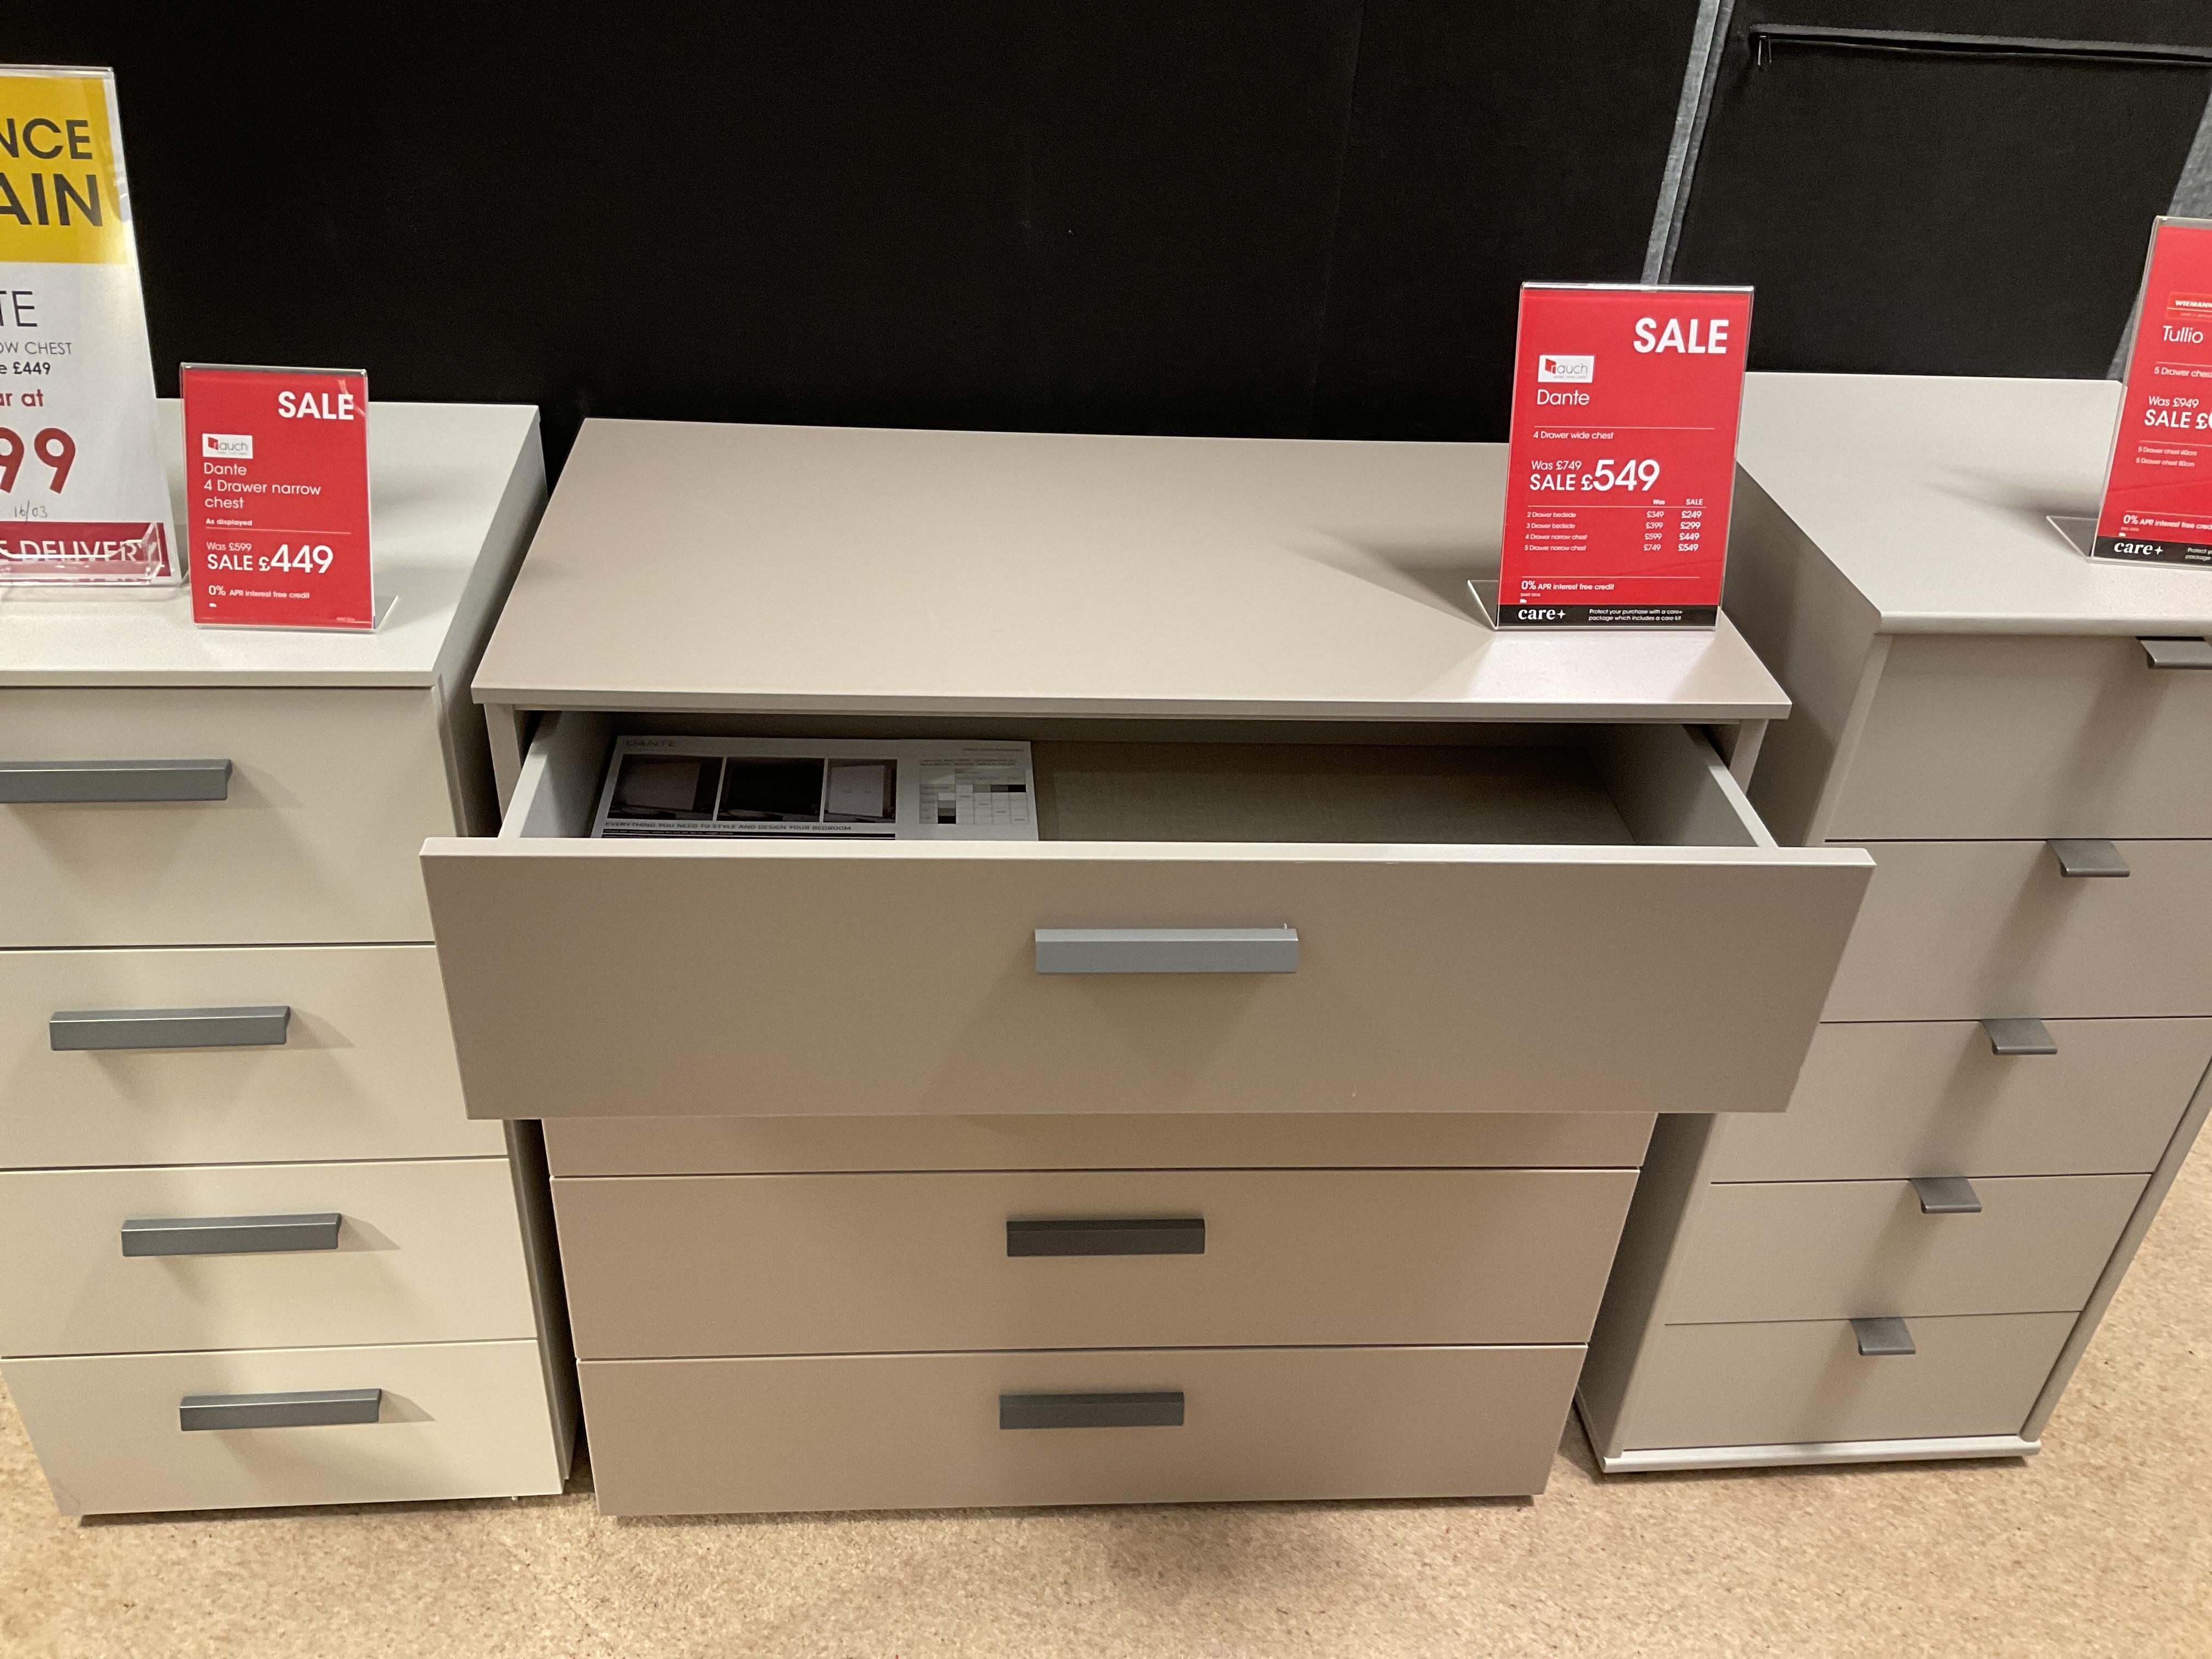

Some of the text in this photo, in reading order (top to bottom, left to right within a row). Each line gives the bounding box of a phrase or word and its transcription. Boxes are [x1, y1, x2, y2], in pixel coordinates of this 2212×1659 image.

[0, 172, 103, 227] AIN
[1633, 317, 1729, 354] SALE
[2163, 325, 2204, 343] Tullio
[0, 342, 72, 355] W CHEST
[13, 362, 50, 375] £449
[2162, 367, 2190, 376] Drawer
[21, 389, 43, 407] at
[1537, 389, 1590, 405] Dante
[2148, 396, 2199, 408] Was £949
[278, 391, 354, 420] SALE
[2144, 409, 2192, 428] SALE
[1541, 431, 1568, 439] Drawer
[1570, 431, 1590, 439] wide
[1592, 431, 1614, 439] chest
[0, 427, 76, 494] 99
[1531, 460, 1582, 470] Was £749
[204, 462, 247, 476] Dante
[1530, 459, 1660, 491] SALE £549
[204, 479, 321, 495] 4 Drawer narrow
[205, 497, 244, 509] chest
[1681, 510, 1702, 518] £249
[2123, 514, 2138, 524] 0%
[217, 518, 252, 527] displayed
[206, 542, 252, 552] Was £599
[1678, 543, 1699, 551] £549
[207, 544, 334, 574] SALE £449
[208, 585, 227, 596] 0%
[245, 590, 271, 598] interest
[273, 590, 288, 599] free
[289, 591, 310, 599] credit
[1521, 580, 1537, 591] 0%
